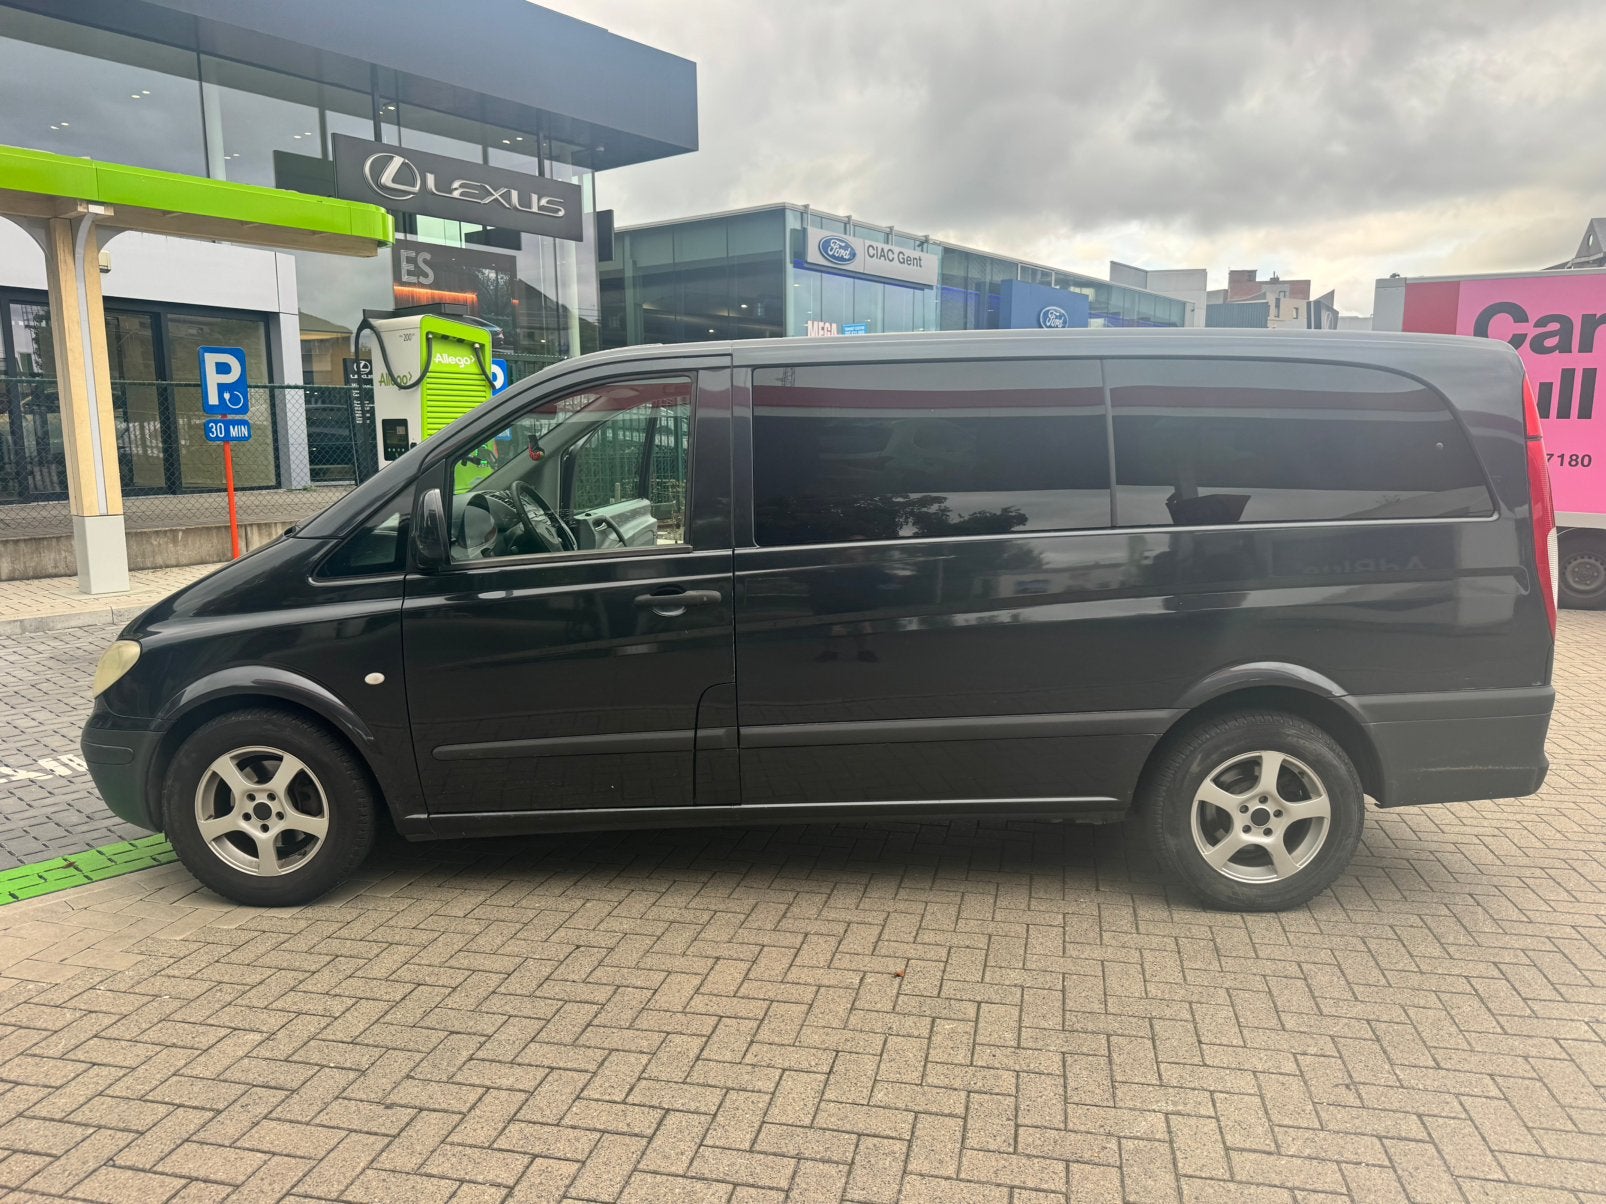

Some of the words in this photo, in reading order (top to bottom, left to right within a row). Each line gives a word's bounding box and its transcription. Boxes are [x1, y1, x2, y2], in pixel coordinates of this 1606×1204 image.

[425, 172, 565, 218] LEXUS
[827, 239, 852, 261] Ford
[866, 244, 896, 262] CIAC
[897, 250, 923, 268] Gent
[400, 249, 435, 285] ES
[1045, 309, 1065, 328] Ford
[434, 353, 471, 368] Allego
[204, 353, 242, 404] P
[378, 372, 409, 391] Allgo
[209, 423, 225, 438] 30
[230, 424, 249, 438] MIN
